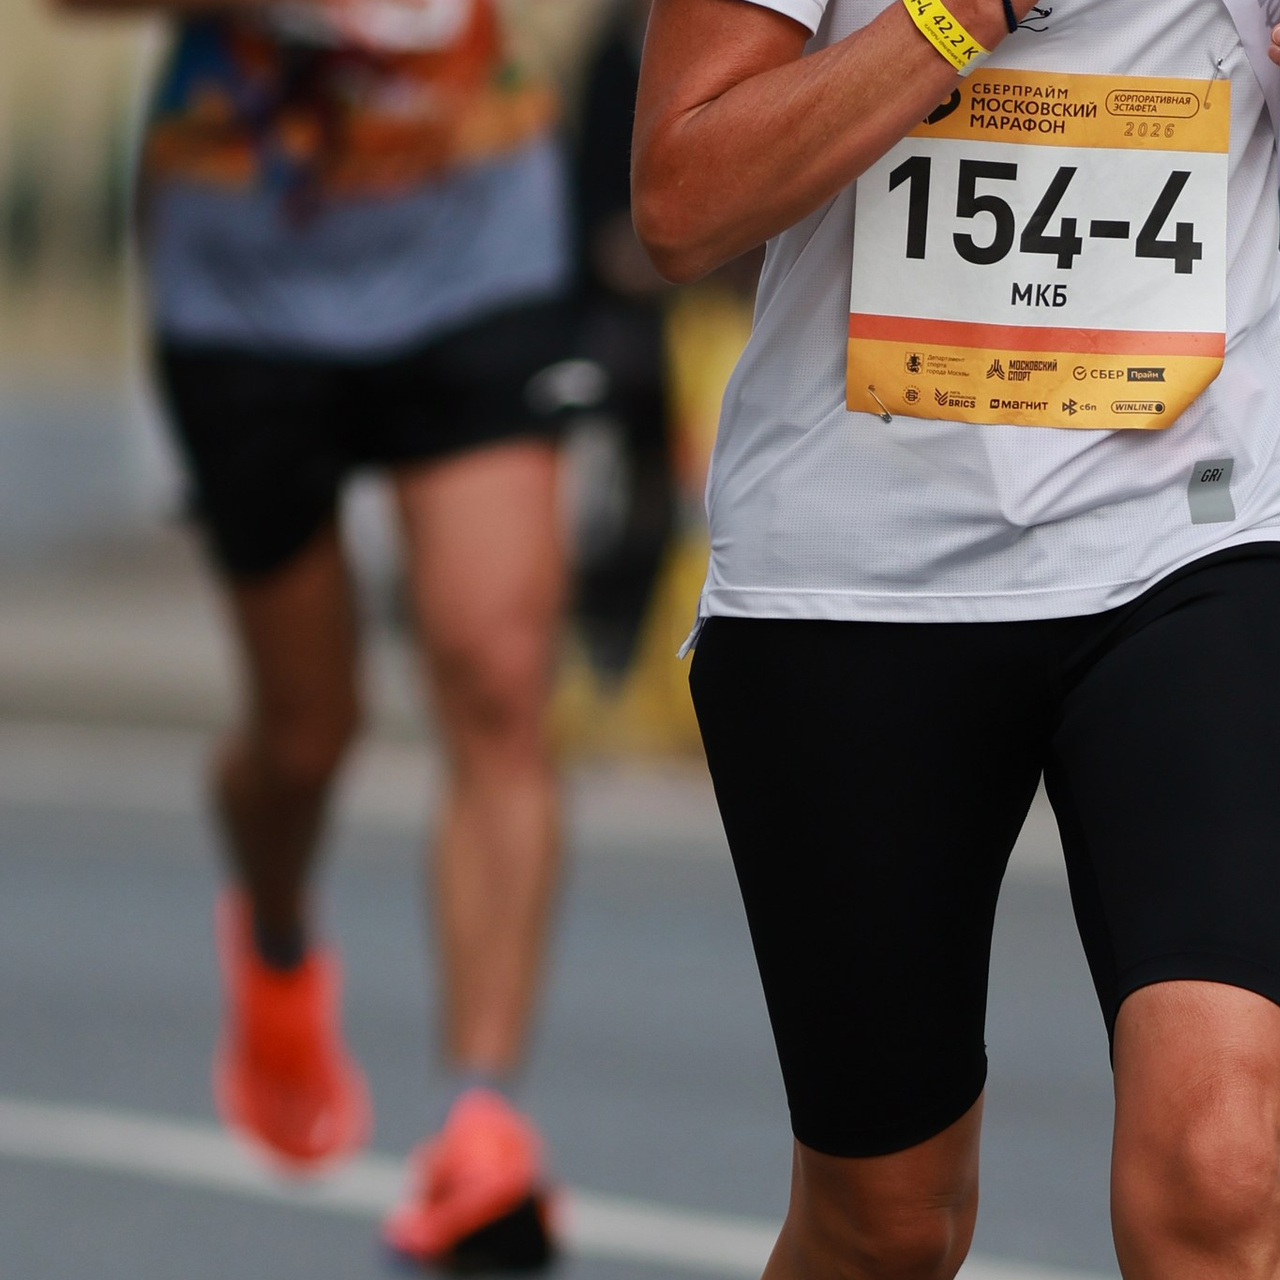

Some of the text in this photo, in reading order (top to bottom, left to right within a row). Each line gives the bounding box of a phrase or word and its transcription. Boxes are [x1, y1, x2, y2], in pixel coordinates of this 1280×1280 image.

[932, 15, 965, 47] 42,2
[972, 83, 1069, 99] СБЕРПРАЙМ
[1113, 94, 1191, 106] КОРПОРАТИВНАЯ
[970, 97, 1098, 118] МОСКОВСКИЙ
[1112, 103, 1158, 113] ЭСТАФЕТА
[969, 114, 1066, 134] МАРАФОН
[1123, 122, 1176, 138] 2026
[888, 155, 1203, 275] 154-4
[1011, 282, 1068, 308] МКБ
[1008, 359, 1058, 372] МОСКОВСКИЙ
[1007, 371, 1031, 381] СПОРТ
[1090, 369, 1159, 380] СБЕР Прайм
[948, 399, 976, 408] BRICS
[1080, 403, 1097, 411] сбп
[1115, 403, 1153, 411] WINLINE
